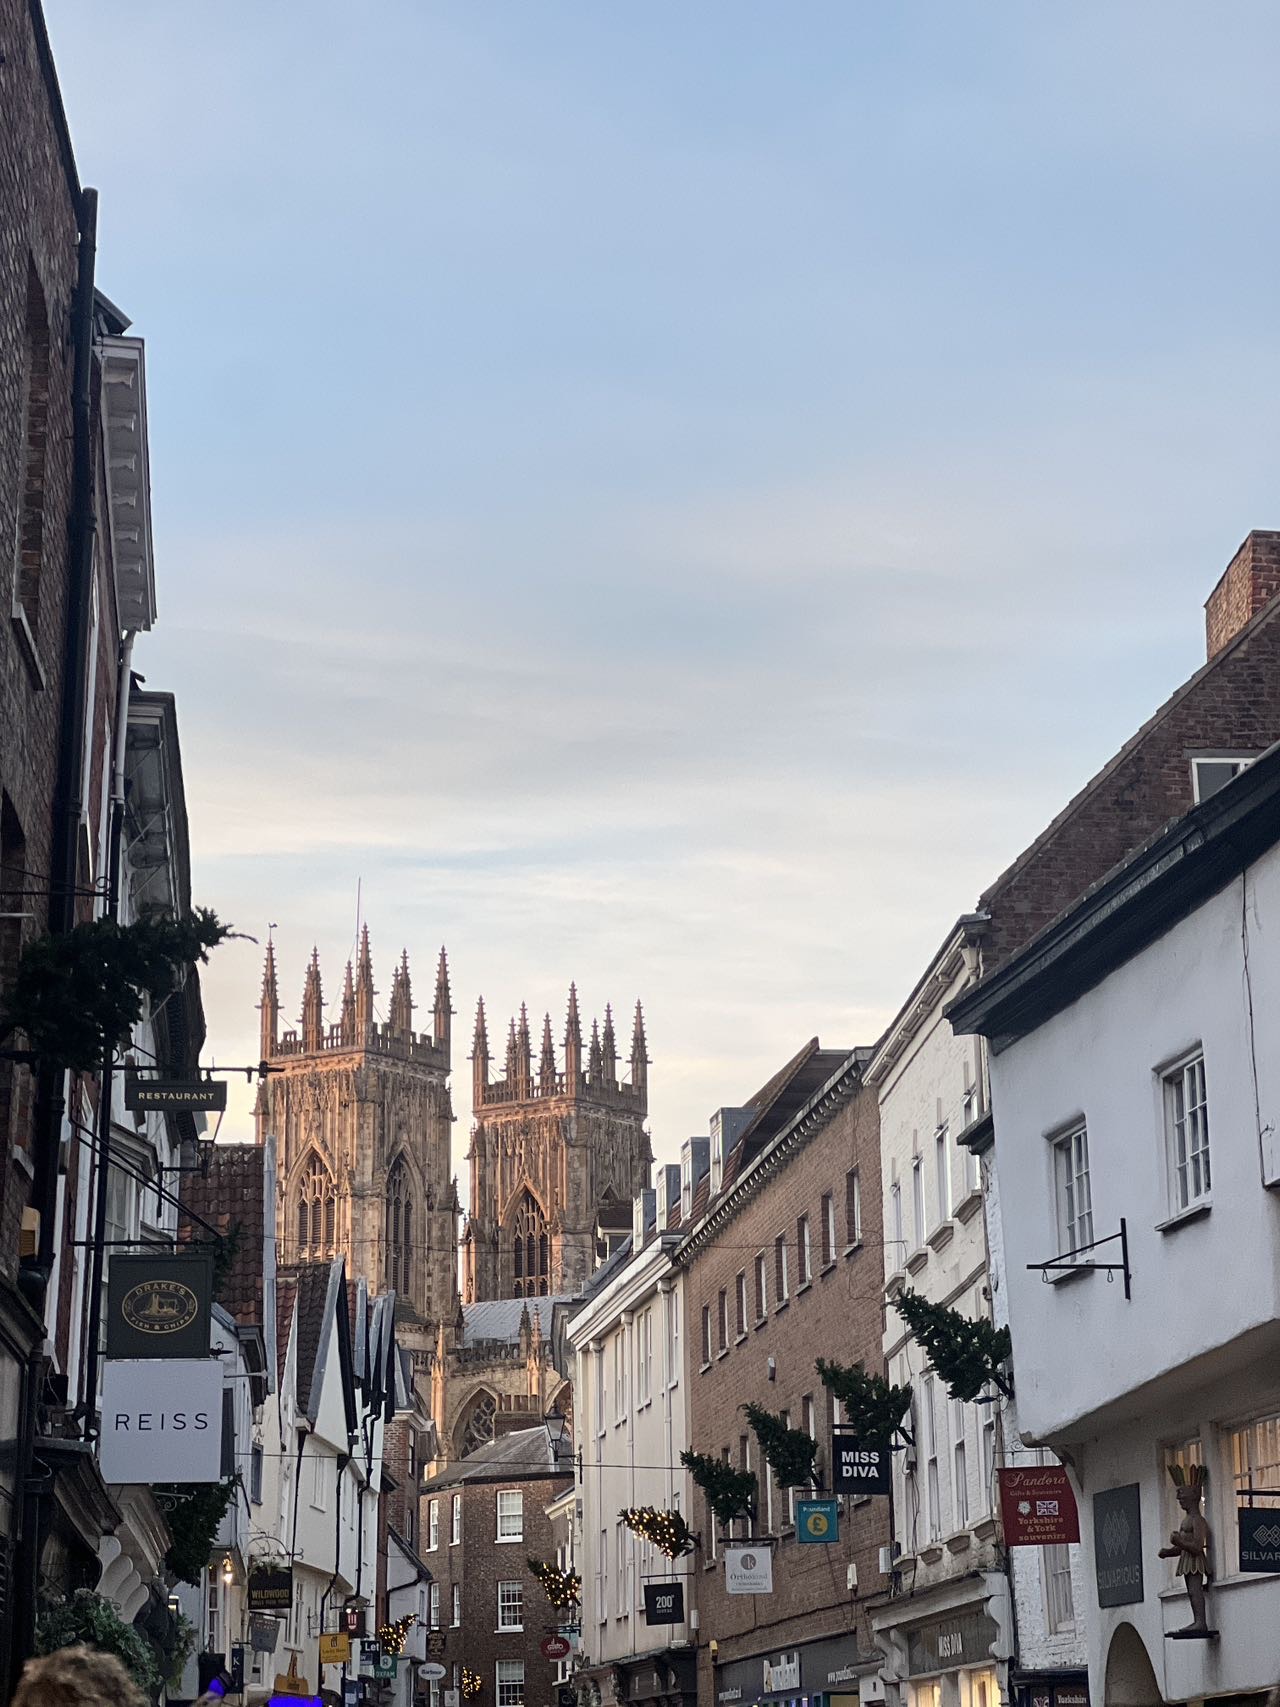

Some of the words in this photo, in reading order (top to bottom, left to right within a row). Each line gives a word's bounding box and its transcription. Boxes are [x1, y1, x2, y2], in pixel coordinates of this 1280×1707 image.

[138, 1092, 214, 1100] RESTAURANT
[135, 1283, 186, 1295] DRAKE'S
[115, 1413, 208, 1431] REISS
[841, 1451, 880, 1463] MISS
[842, 1466, 879, 1478] DIVA
[1005, 1472, 1066, 1488] Pandora
[1017, 1517, 1064, 1525] Yorkshire
[252, 1589, 290, 1599] WILDWOOD
